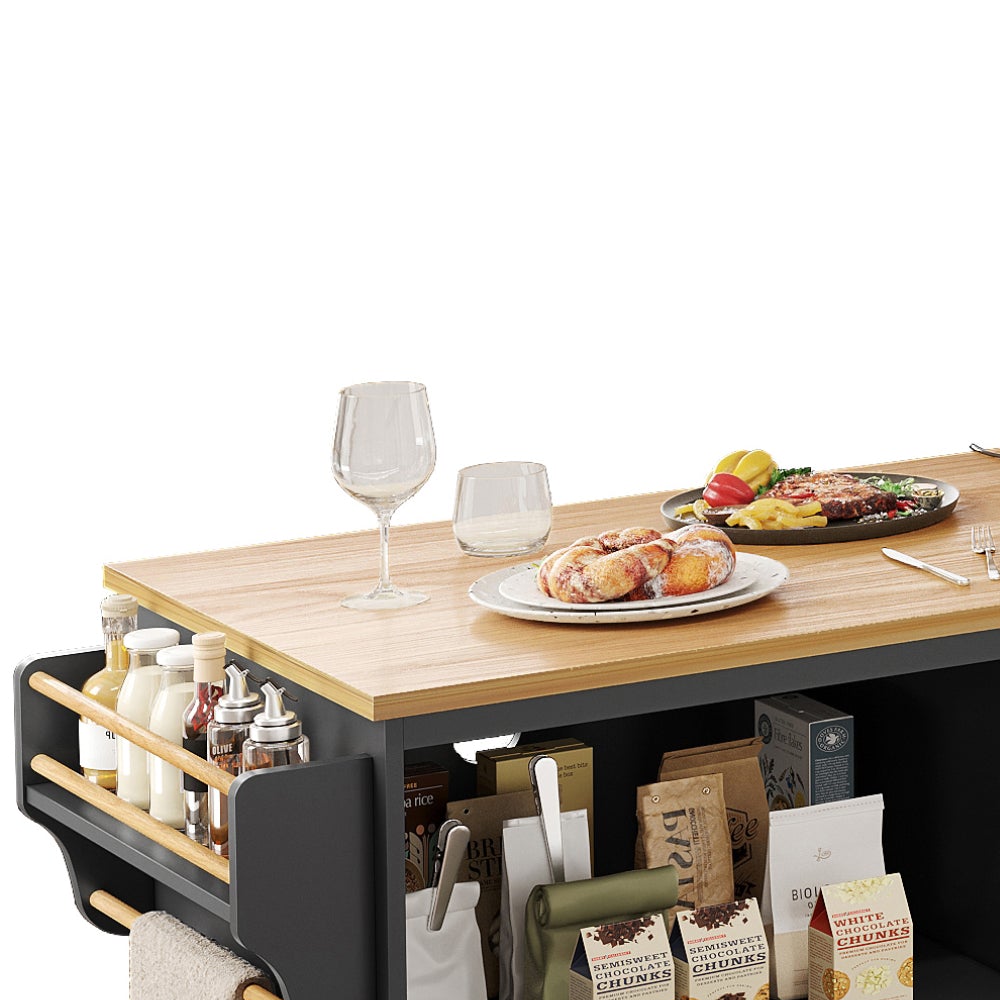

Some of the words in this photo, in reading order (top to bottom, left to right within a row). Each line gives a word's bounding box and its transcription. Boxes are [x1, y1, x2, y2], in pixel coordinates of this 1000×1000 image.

[212, 744, 234, 756] OLIVE
[414, 793, 434, 807] rice
[834, 912, 885, 928] WHITE
[836, 918, 909, 936] CHOCOLATE
[689, 935, 762, 954] SEMISWEET
[837, 926, 910, 947] CHUNKS
[593, 952, 668, 972] SEMISWEET
[692, 943, 765, 962] CHOCOLATE
[596, 960, 671, 980] CHOCOLATE
[693, 952, 766, 973] CHUNKS
[597, 969, 672, 991] CHUNKS
